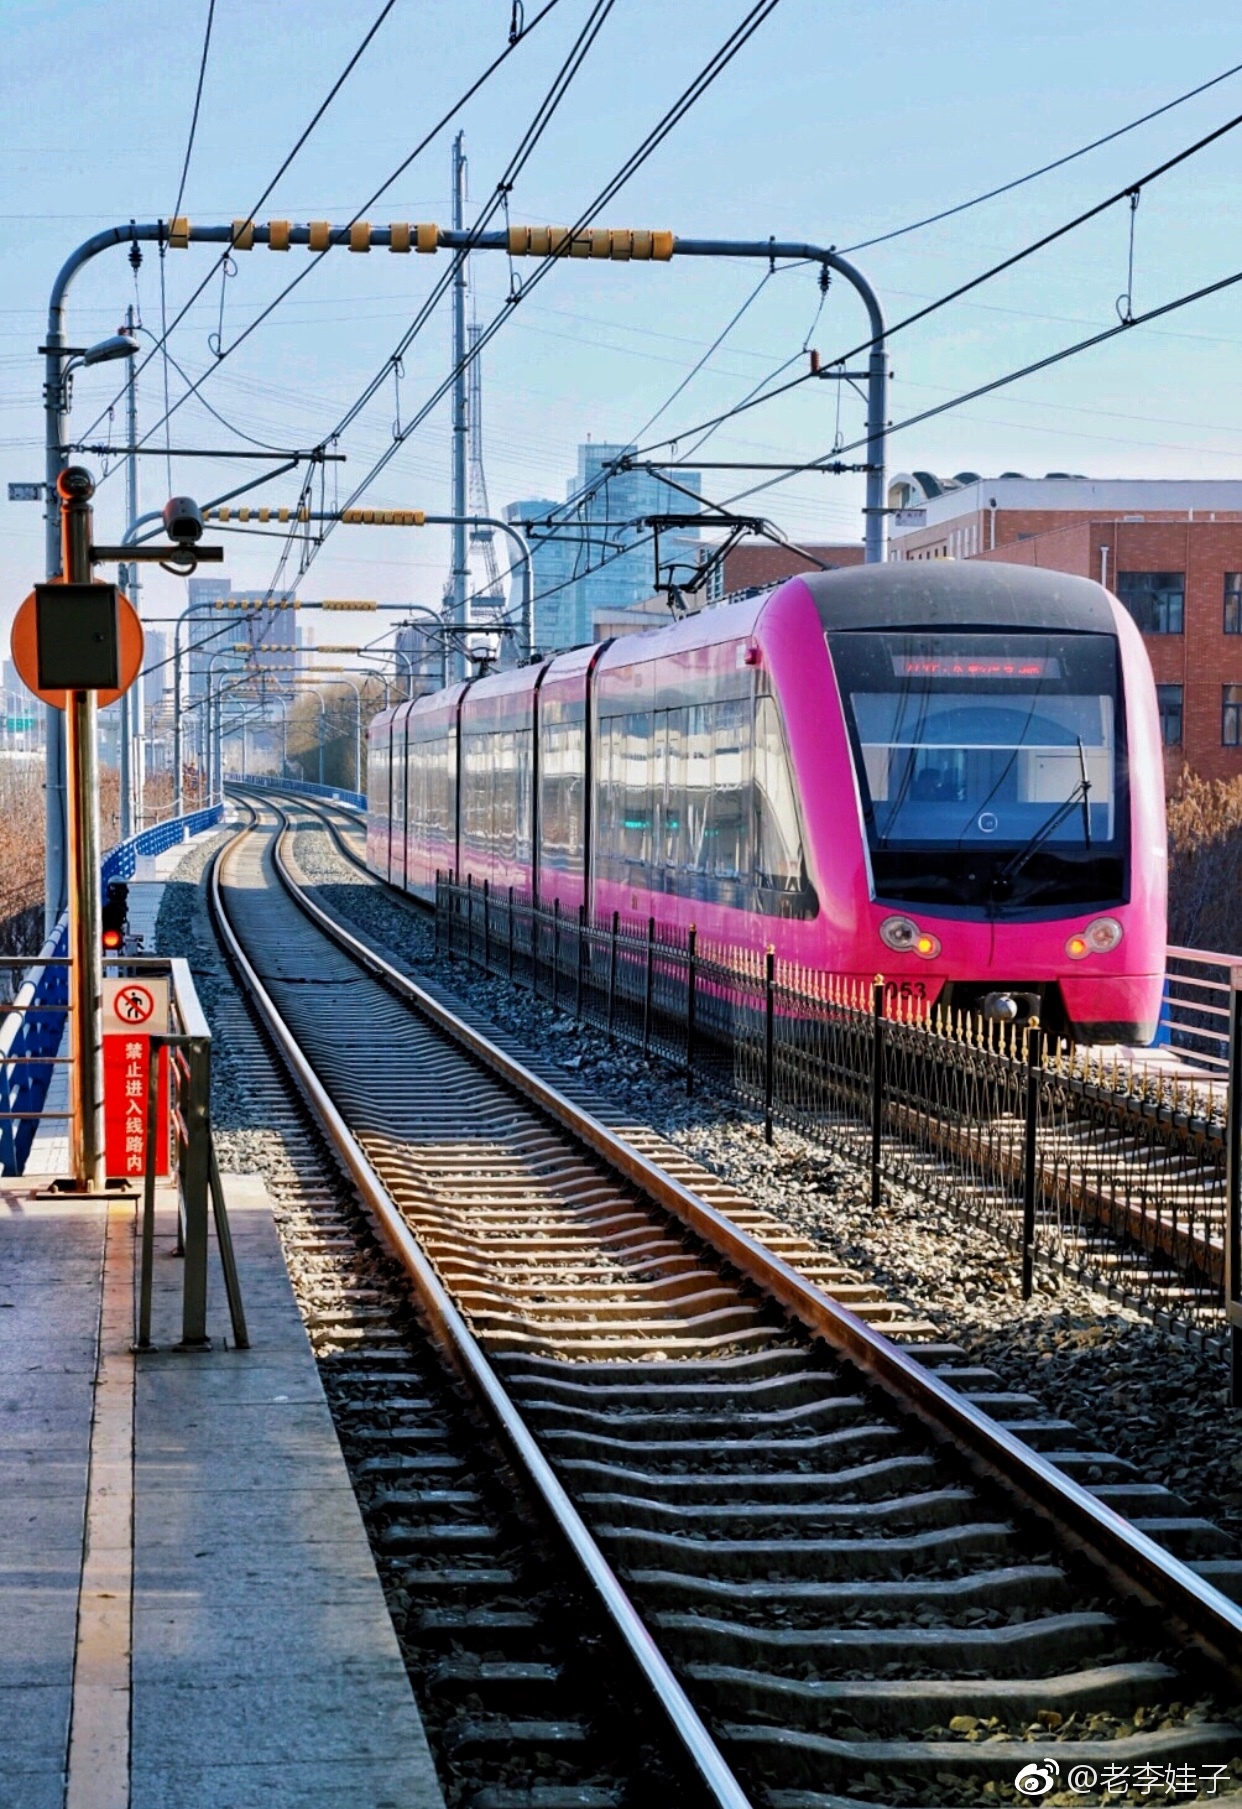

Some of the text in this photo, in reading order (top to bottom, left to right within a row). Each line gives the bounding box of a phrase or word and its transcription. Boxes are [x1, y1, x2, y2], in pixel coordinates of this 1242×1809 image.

[125, 1042, 143, 1172] 禁止进入线路内
